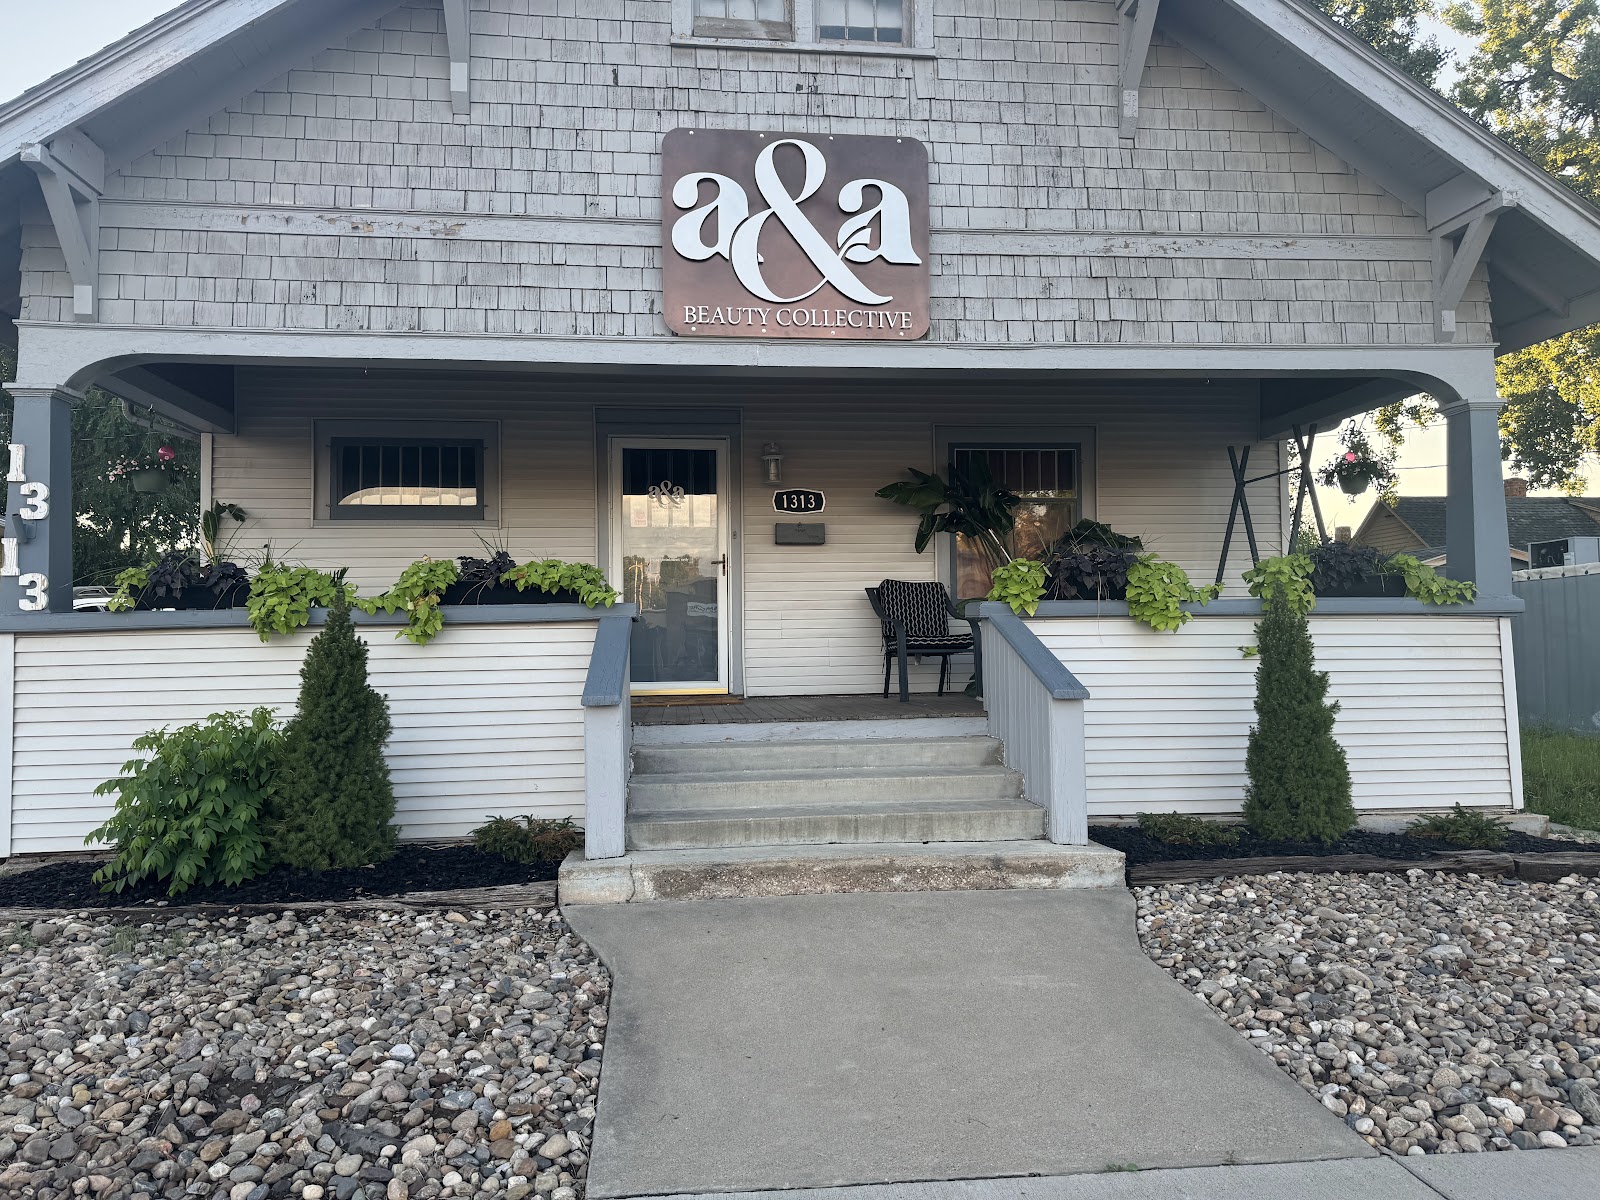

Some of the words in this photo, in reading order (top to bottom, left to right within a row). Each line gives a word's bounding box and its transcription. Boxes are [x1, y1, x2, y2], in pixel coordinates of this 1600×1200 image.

[671, 138, 923, 305] a&a
[683, 305, 772, 326] BEAUTY
[775, 308, 913, 330] COLLECTIVE
[648, 480, 686, 506] a&a
[782, 494, 816, 509] 1313
